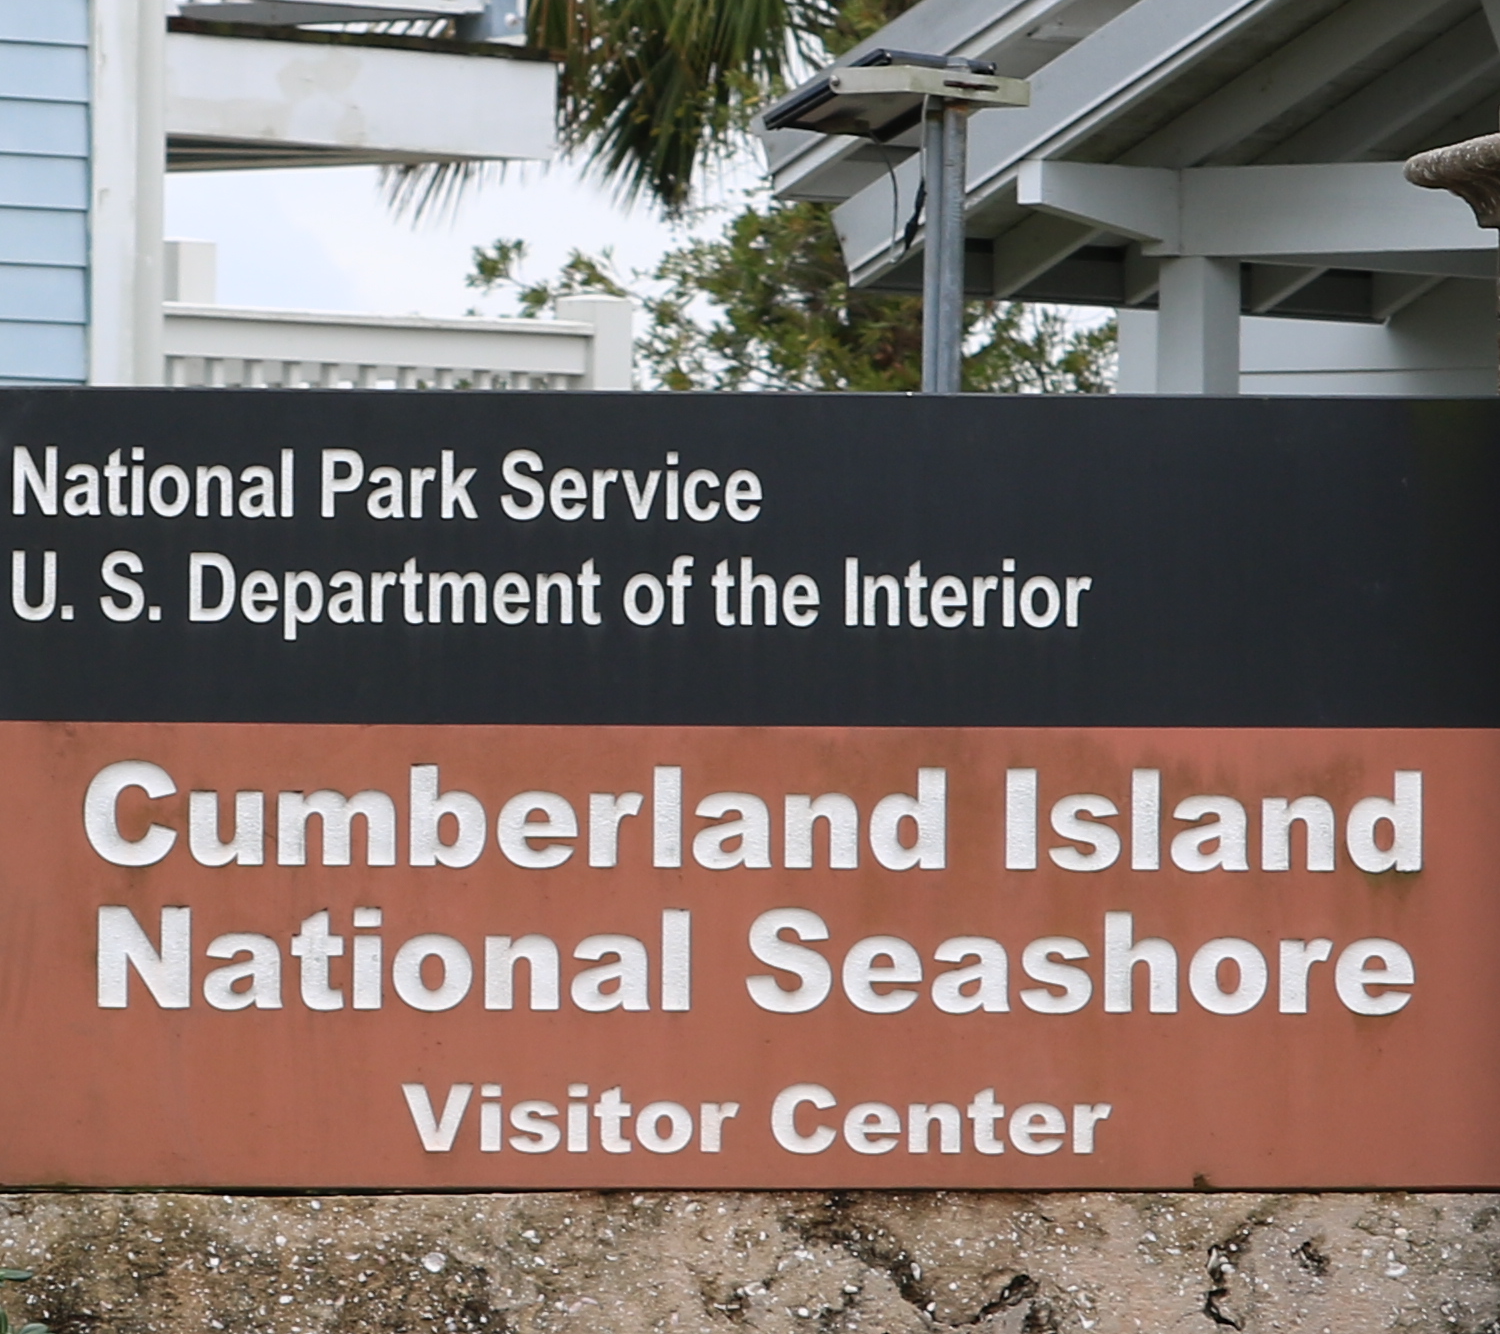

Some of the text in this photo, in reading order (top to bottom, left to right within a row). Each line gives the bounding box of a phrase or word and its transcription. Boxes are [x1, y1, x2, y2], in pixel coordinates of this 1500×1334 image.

[13, 447, 762, 521] National Park Service
[13, 551, 1091, 640] U. S. Department of the Interior
[85, 763, 1422, 872] Cumberland Island
[98, 908, 1414, 1014] National Seashore
[402, 1085, 1111, 1154] Visitor Center
